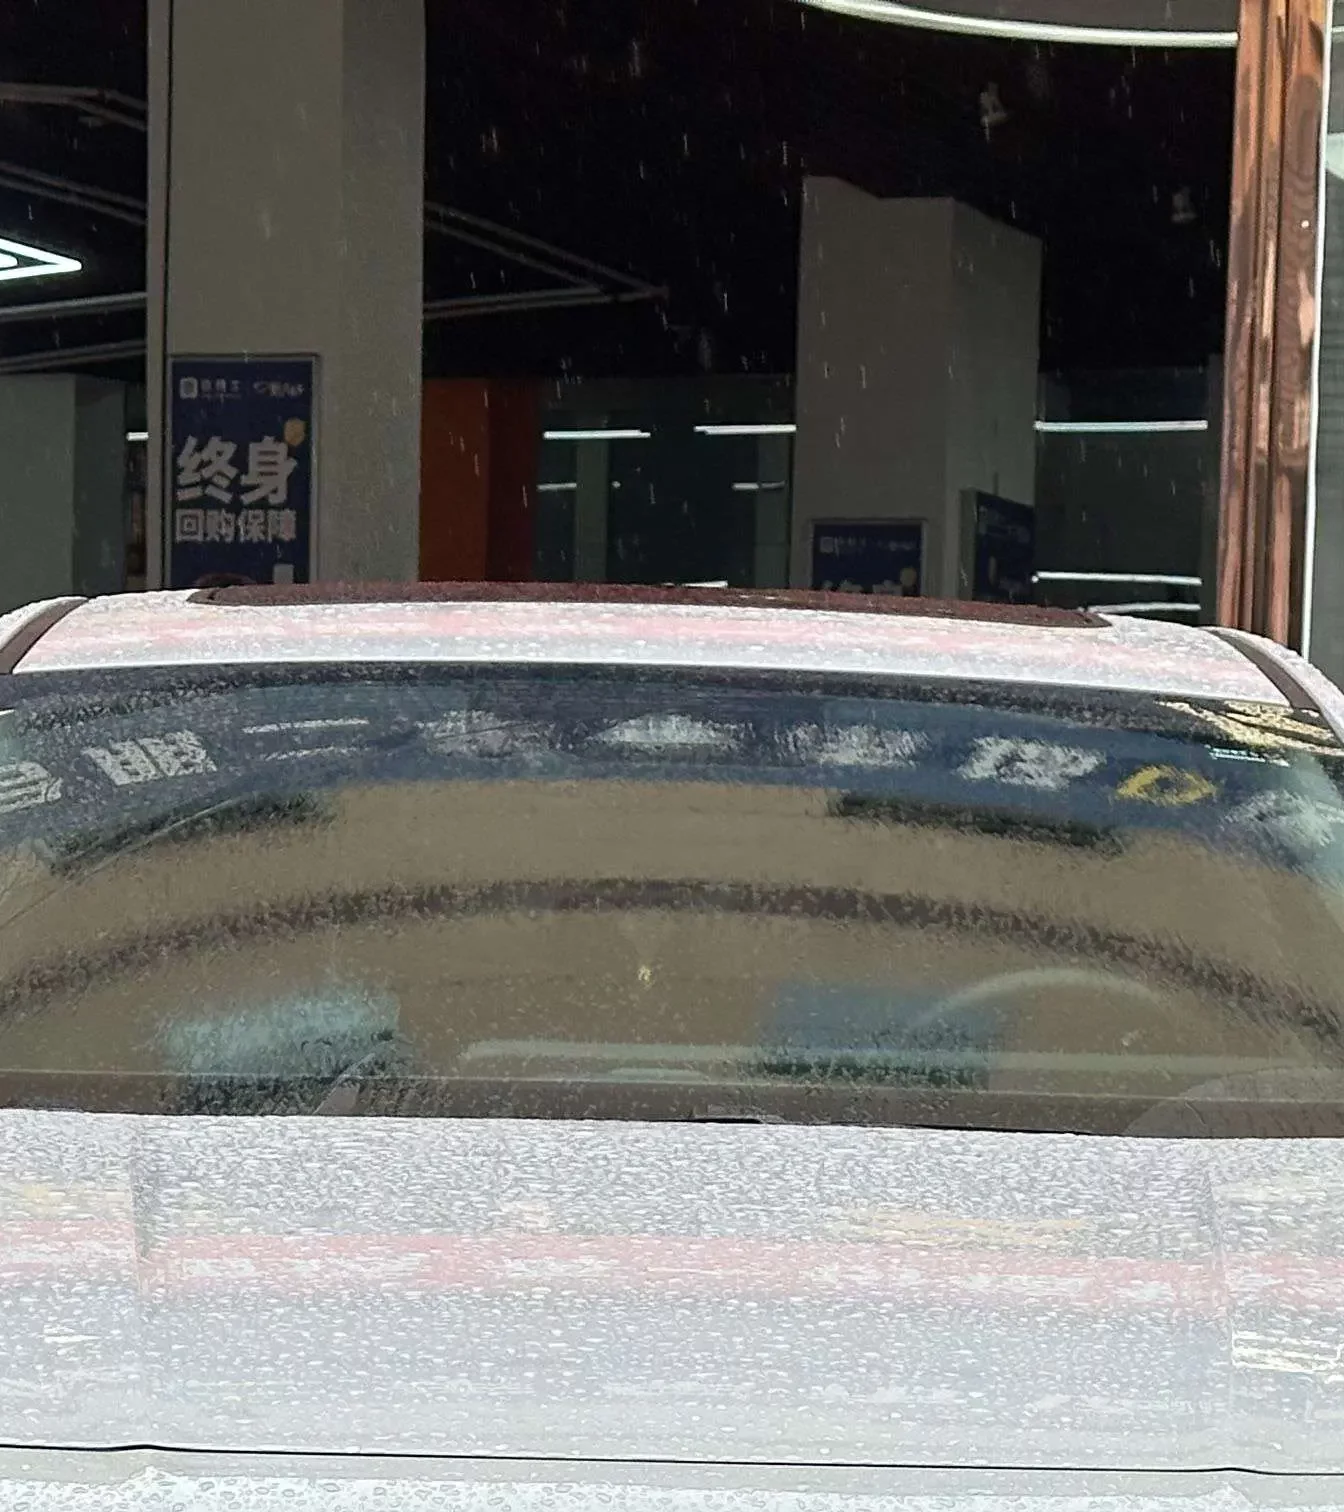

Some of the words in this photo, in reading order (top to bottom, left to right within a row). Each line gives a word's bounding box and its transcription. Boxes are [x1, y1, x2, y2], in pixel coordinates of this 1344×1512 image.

[176, 435, 298, 505] 终身
[175, 507, 298, 544] 回购保障
